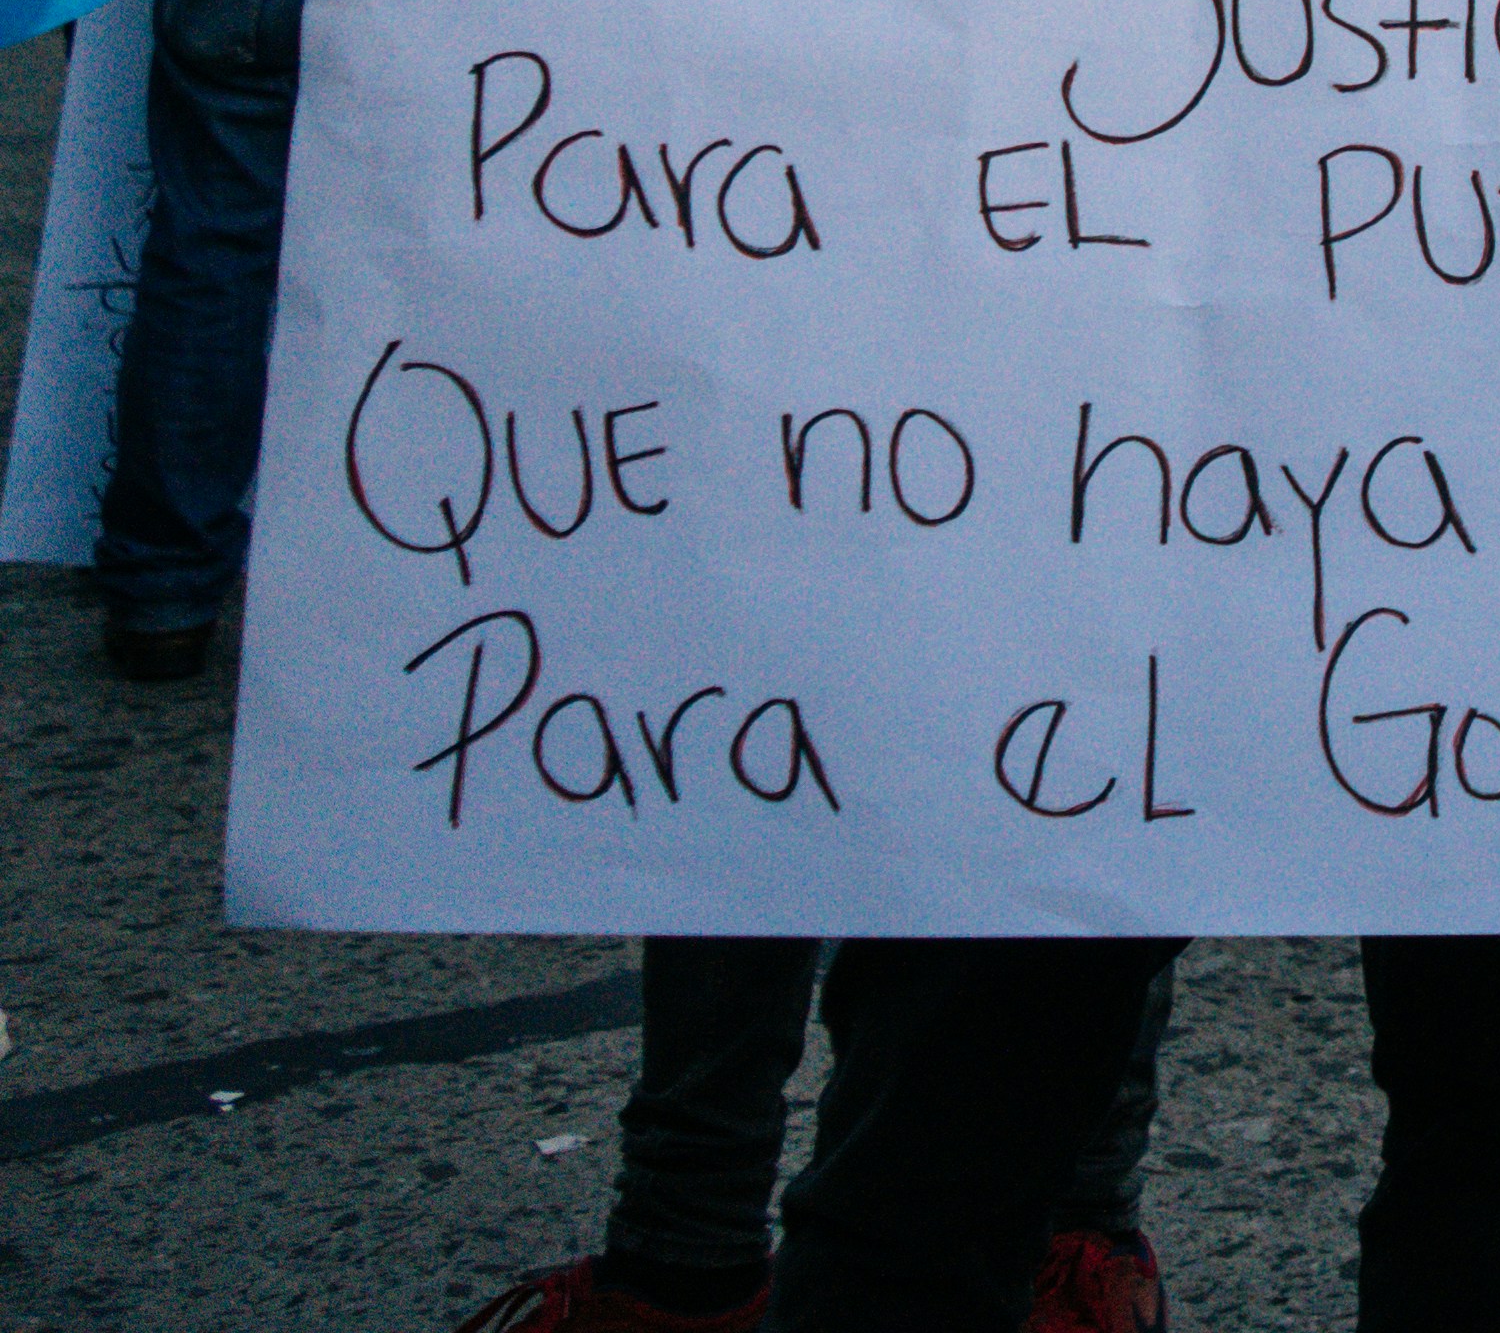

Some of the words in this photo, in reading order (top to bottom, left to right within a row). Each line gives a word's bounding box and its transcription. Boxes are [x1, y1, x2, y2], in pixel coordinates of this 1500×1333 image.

[467, 49, 823, 261] Para
[976, 138, 1151, 254] EL
[344, 338, 671, 588] QUE
[779, 402, 977, 529] no
[1069, 400, 1479, 654] haya
[402, 608, 842, 830] Para
